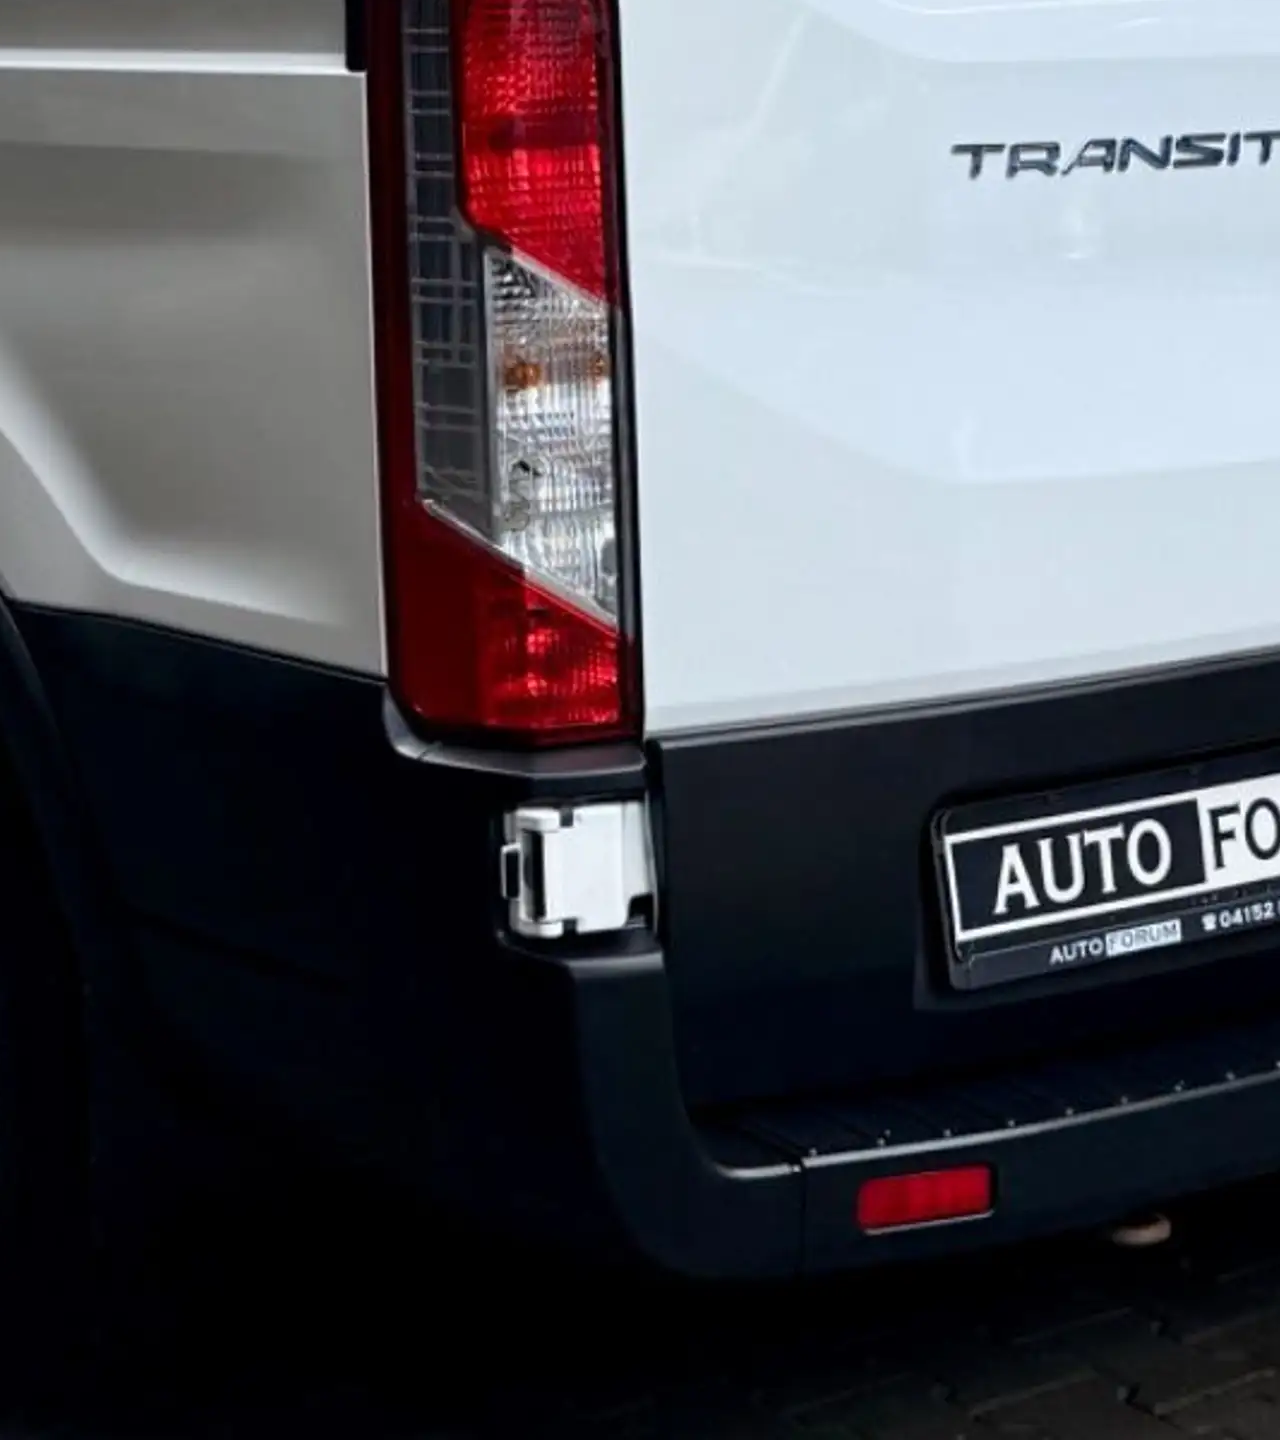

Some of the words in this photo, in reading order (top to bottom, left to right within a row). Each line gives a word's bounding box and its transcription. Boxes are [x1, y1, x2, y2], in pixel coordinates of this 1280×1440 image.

[993, 818, 1172, 915] AUTO
[1220, 902, 1274, 928] 04152
[1050, 937, 1105, 965] AUTO
[1108, 922, 1179, 954] FORUM
